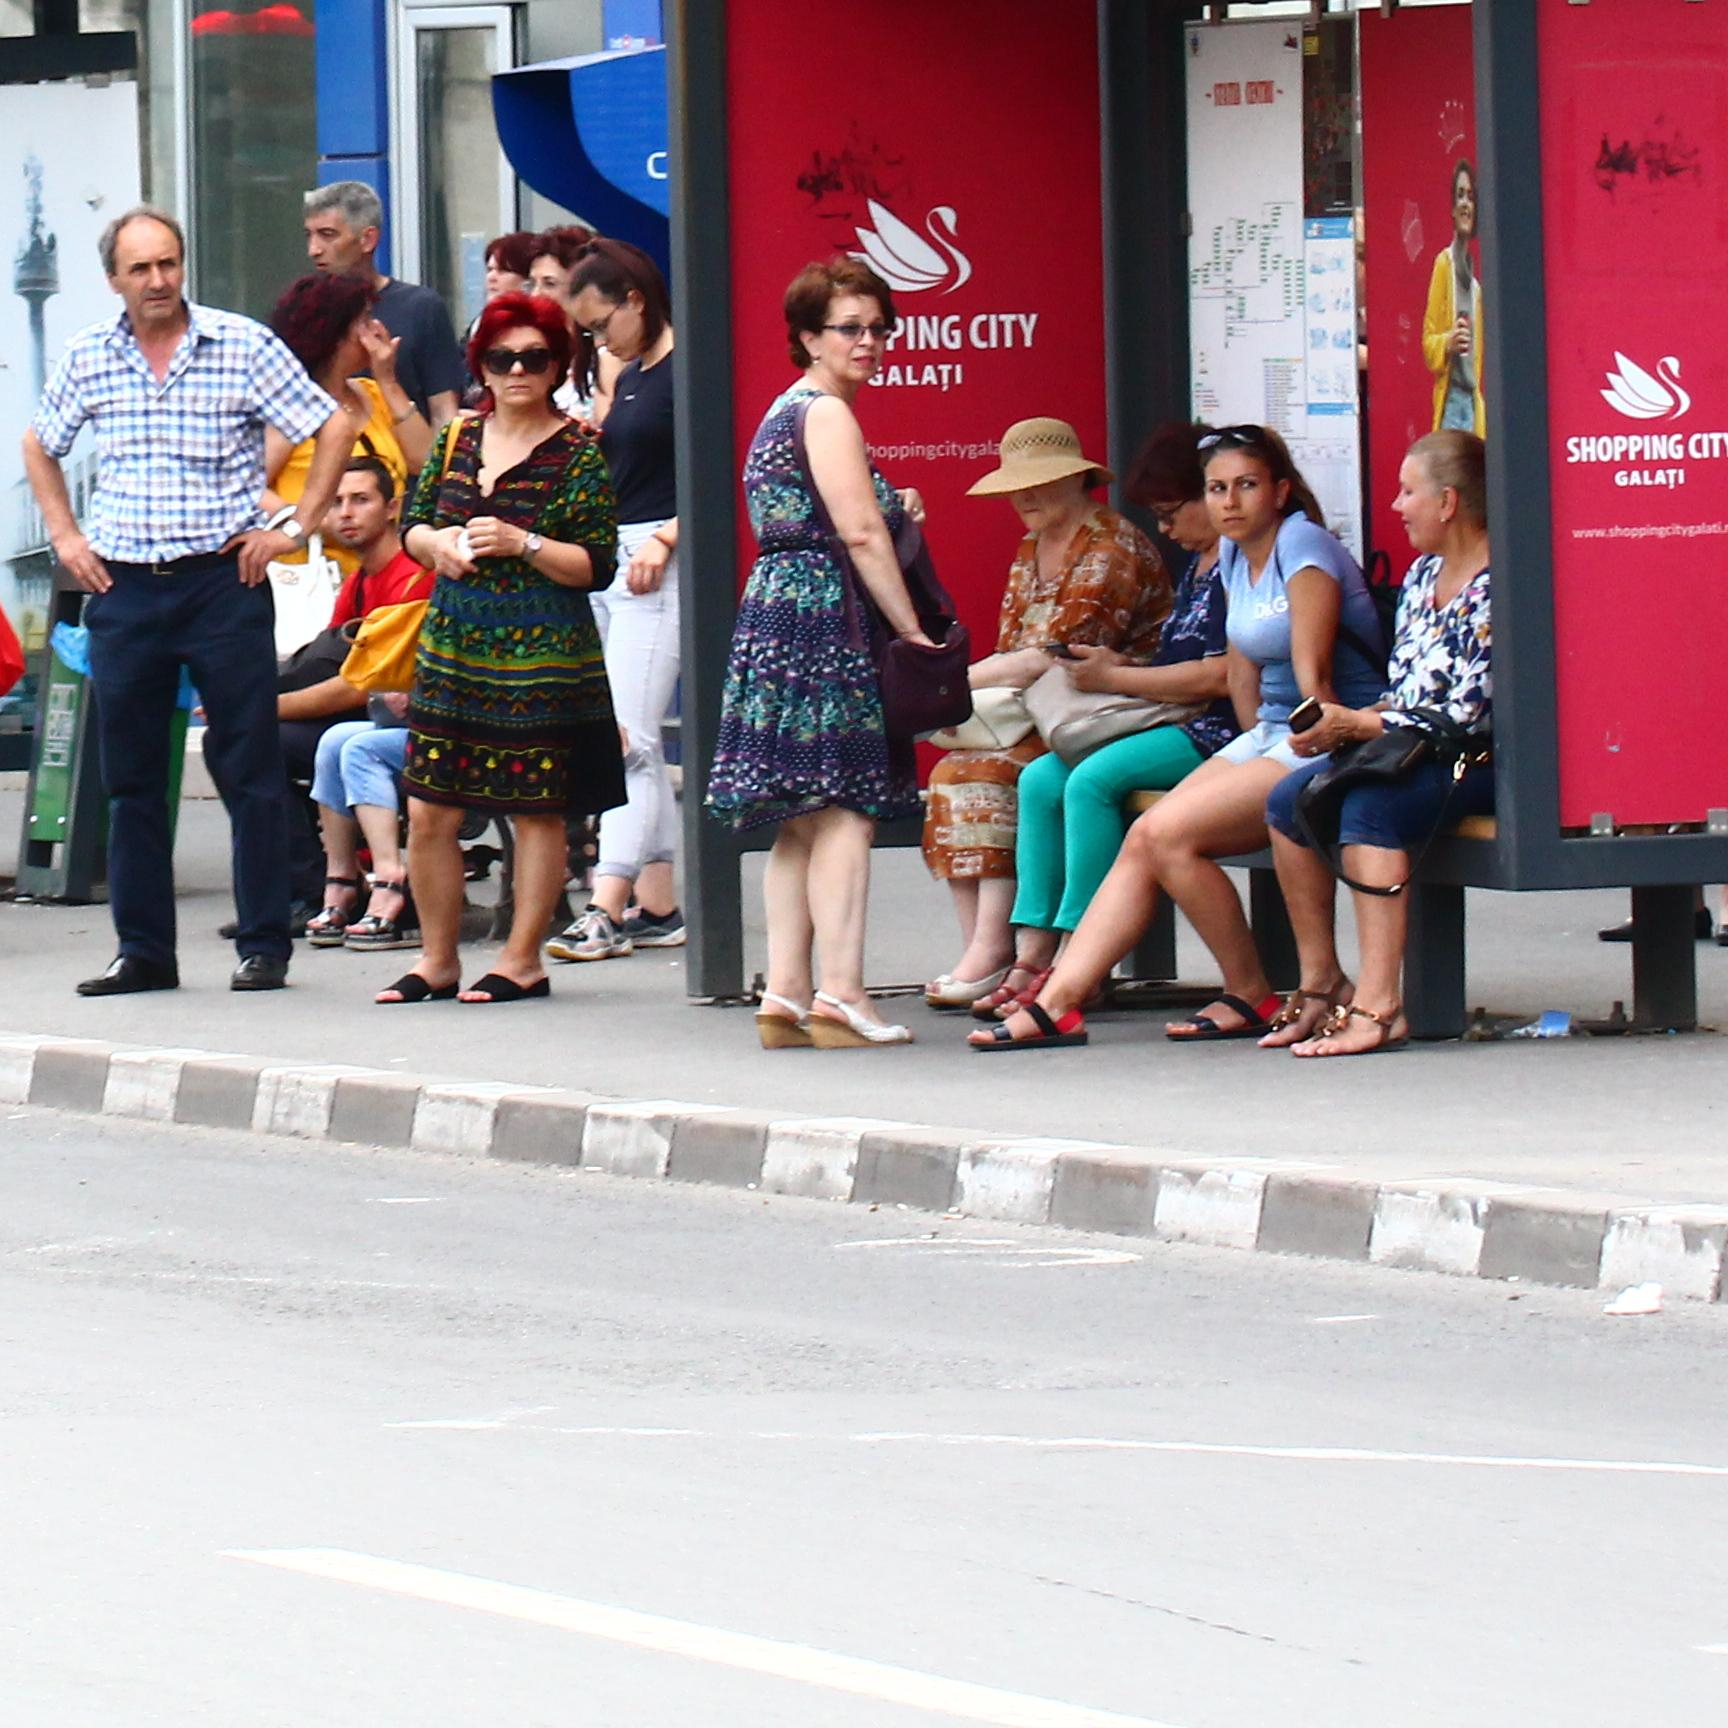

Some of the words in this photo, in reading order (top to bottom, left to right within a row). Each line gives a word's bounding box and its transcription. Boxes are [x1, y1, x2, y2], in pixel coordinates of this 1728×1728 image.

[885, 314, 962, 352] PING
[968, 313, 1039, 350] CITY
[866, 439, 1003, 461] hoppingcitygala
[1566, 433, 1685, 464] SHOPPING
